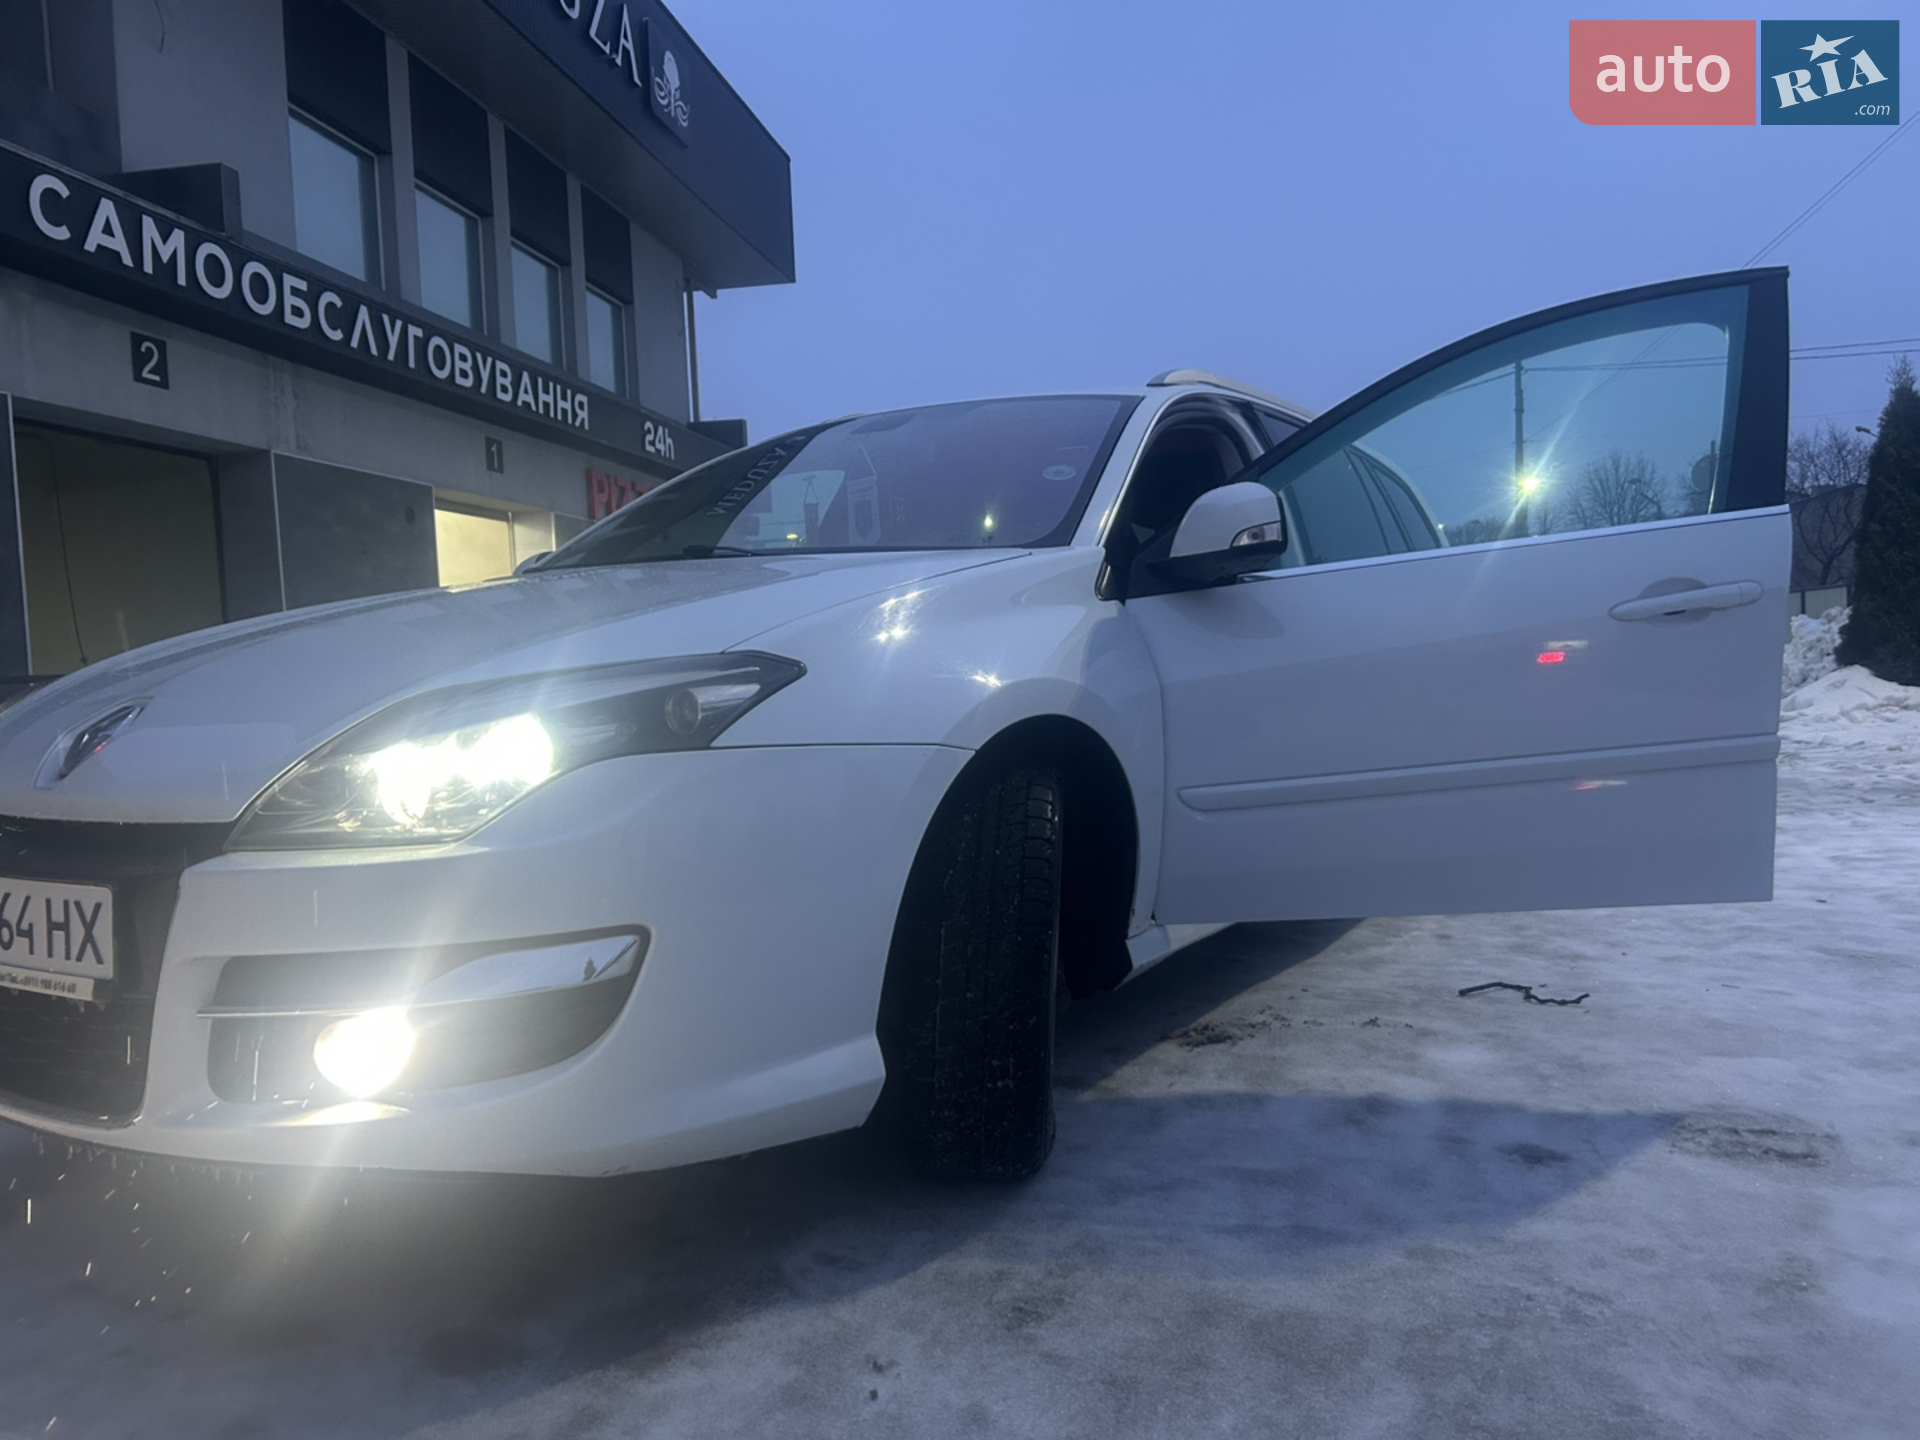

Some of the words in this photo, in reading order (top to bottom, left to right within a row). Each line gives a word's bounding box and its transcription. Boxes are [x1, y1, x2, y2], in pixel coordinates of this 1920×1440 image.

[560, 0, 642, 88] ZA
[28, 173, 589, 430] САМООБСЛУГОВУВАННЯ
[140, 341, 161, 382] 2
[490, 442, 498, 469] 1
[644, 420, 675, 460] 24h
[586, 469, 651, 521] PIZ
[45, 897, 104, 965] HX
